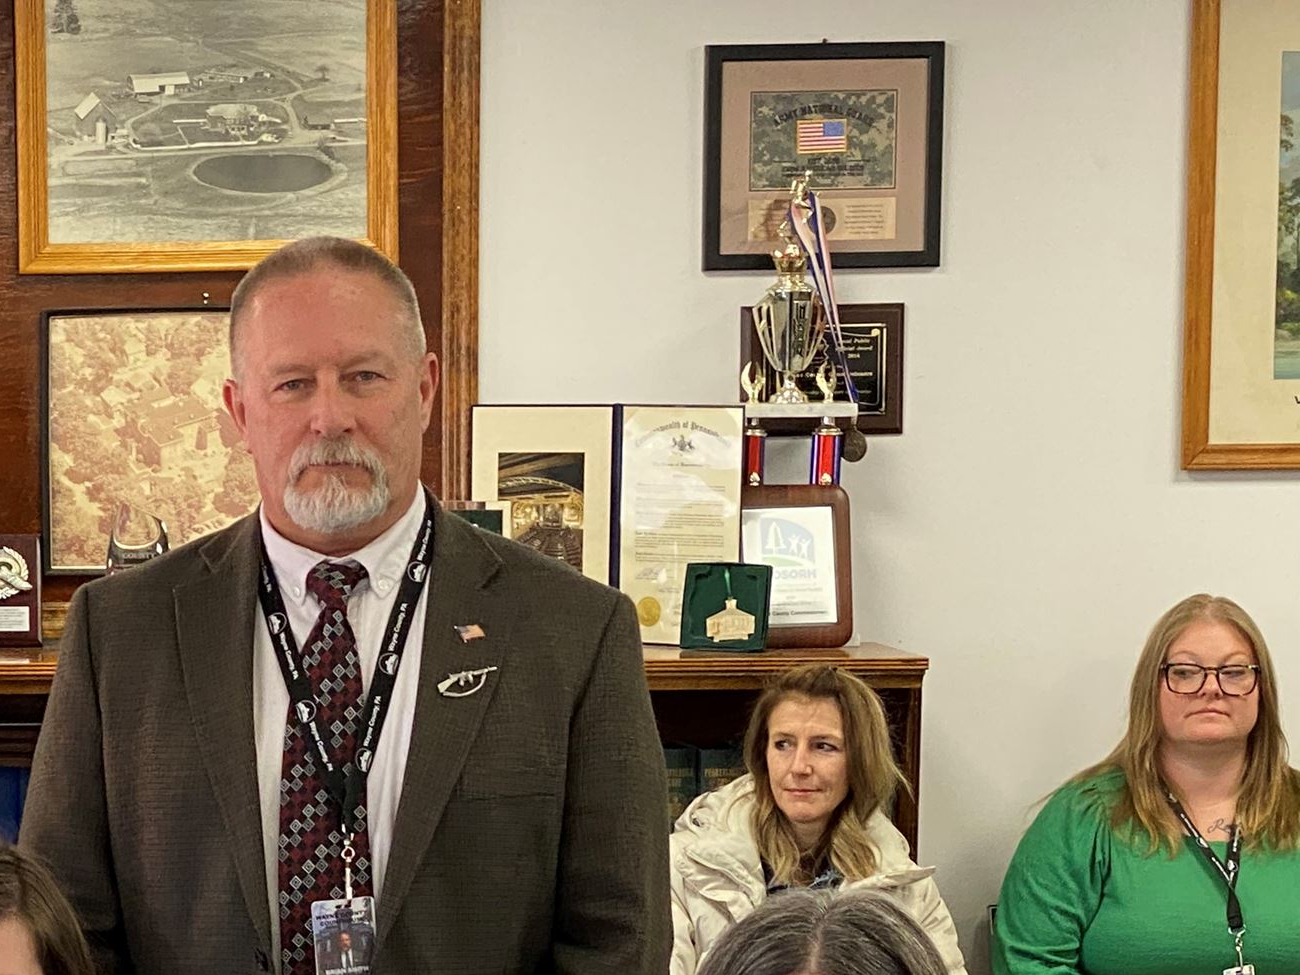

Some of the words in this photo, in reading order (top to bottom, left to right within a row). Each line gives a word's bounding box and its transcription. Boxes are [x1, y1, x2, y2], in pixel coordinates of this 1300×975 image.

[417, 544, 426, 561] Wayne
[388, 633, 398, 651] Wayne
[394, 612, 405, 632] County,
[400, 603, 408, 611] PA
[280, 632, 288, 650] Wayne
[292, 670, 299, 680] PA
[309, 721, 320, 741] Wayne
[363, 726, 373, 747] Wayne
[368, 705, 380, 727] County,
[374, 696, 381, 704] PA
